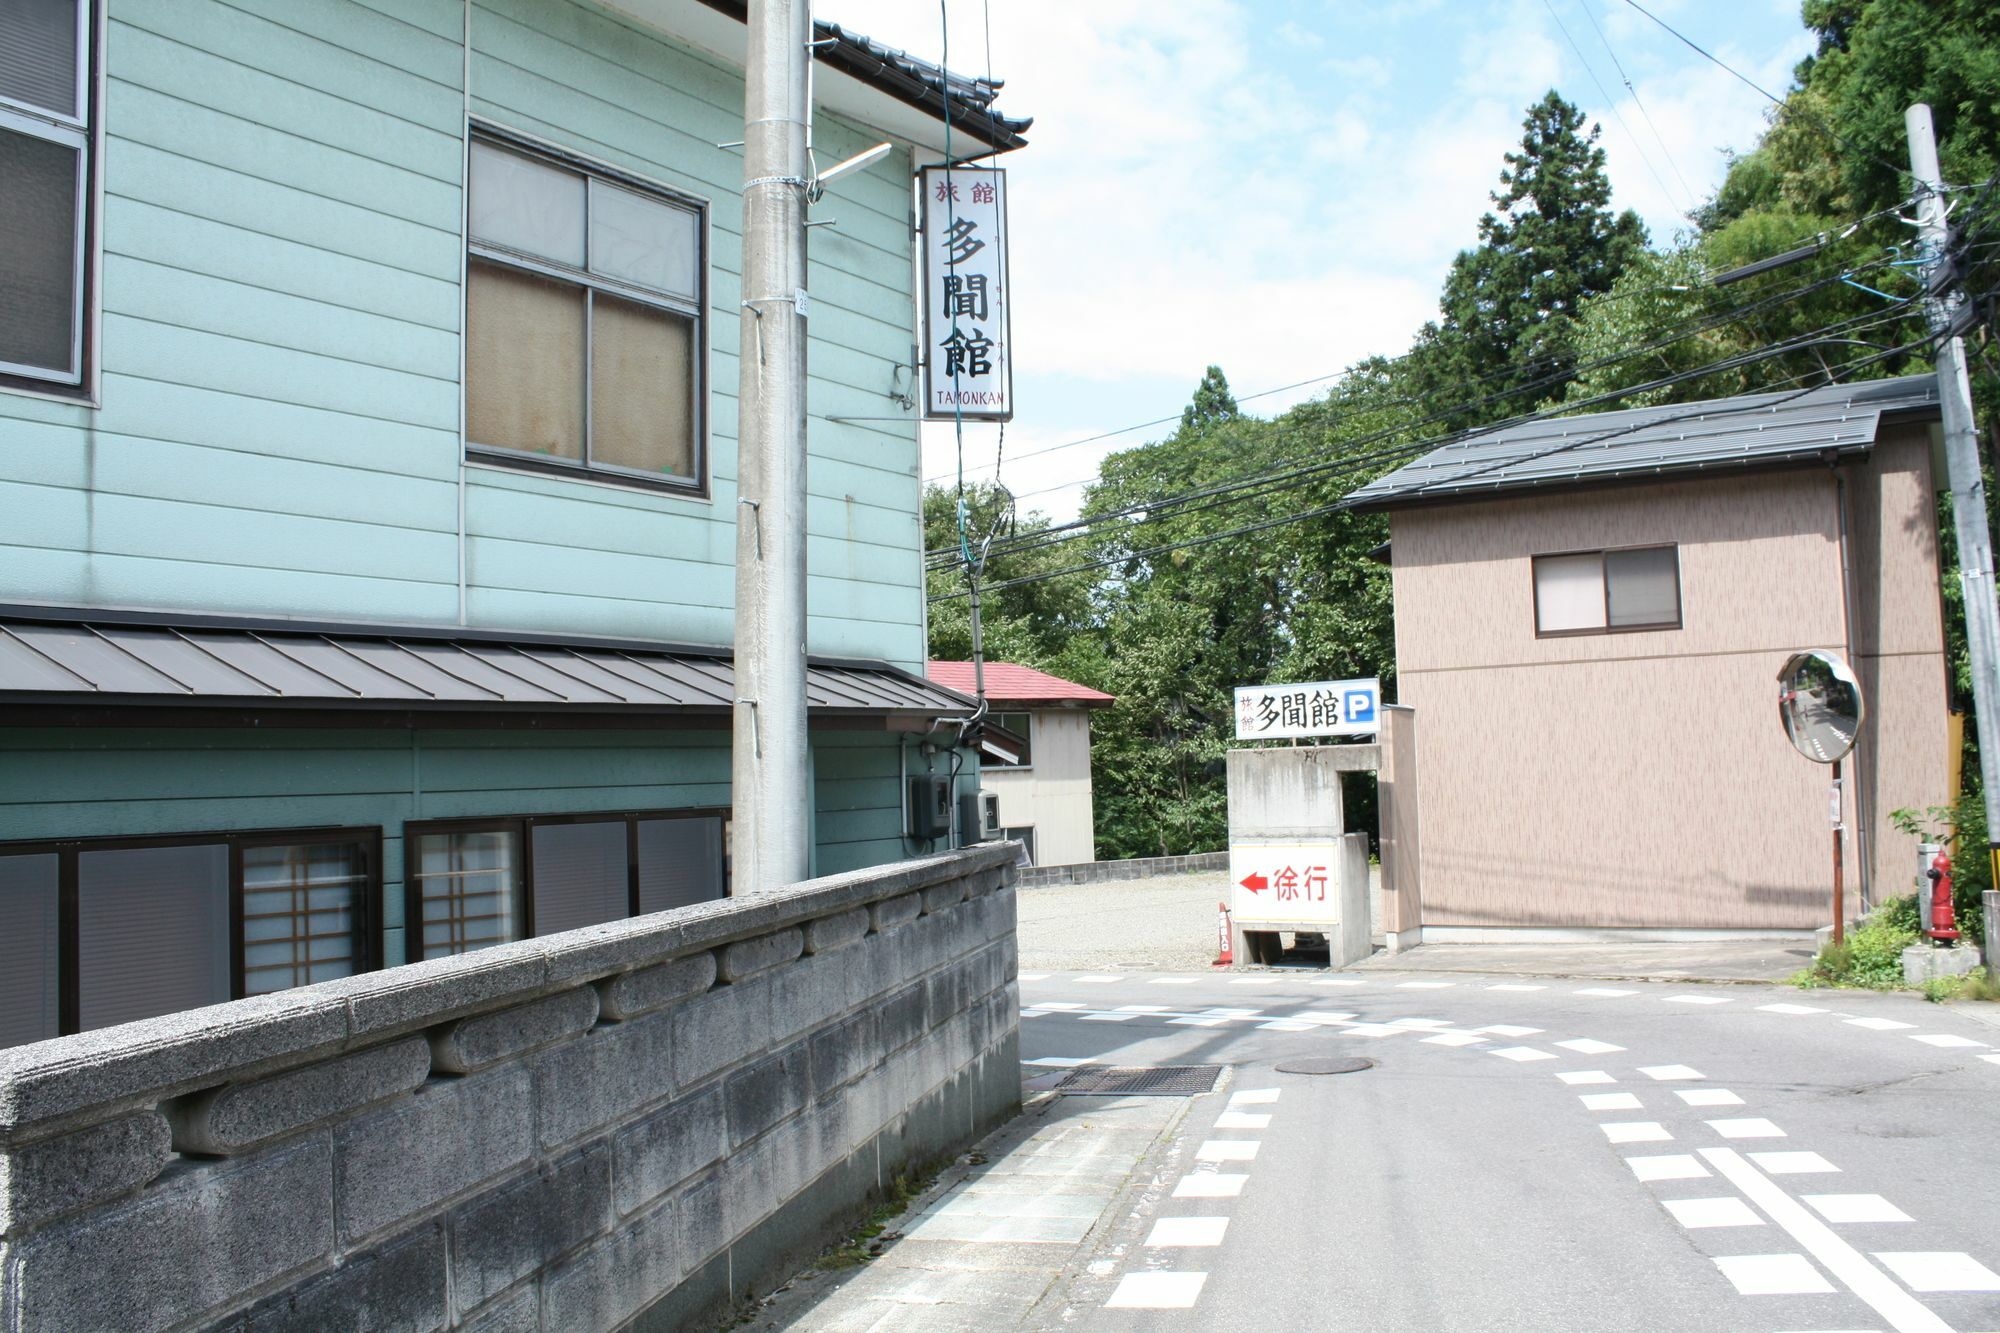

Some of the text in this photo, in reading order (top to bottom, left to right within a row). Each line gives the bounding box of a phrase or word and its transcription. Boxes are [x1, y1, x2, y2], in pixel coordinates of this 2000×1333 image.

[935, 181, 995, 204] 旅館
[939, 216, 995, 378] 多聞館
[937, 391, 1004, 405] TAMONKAN
[1256, 690, 1370, 731] 多聞館 P
[1274, 865, 1328, 901] 徐行
